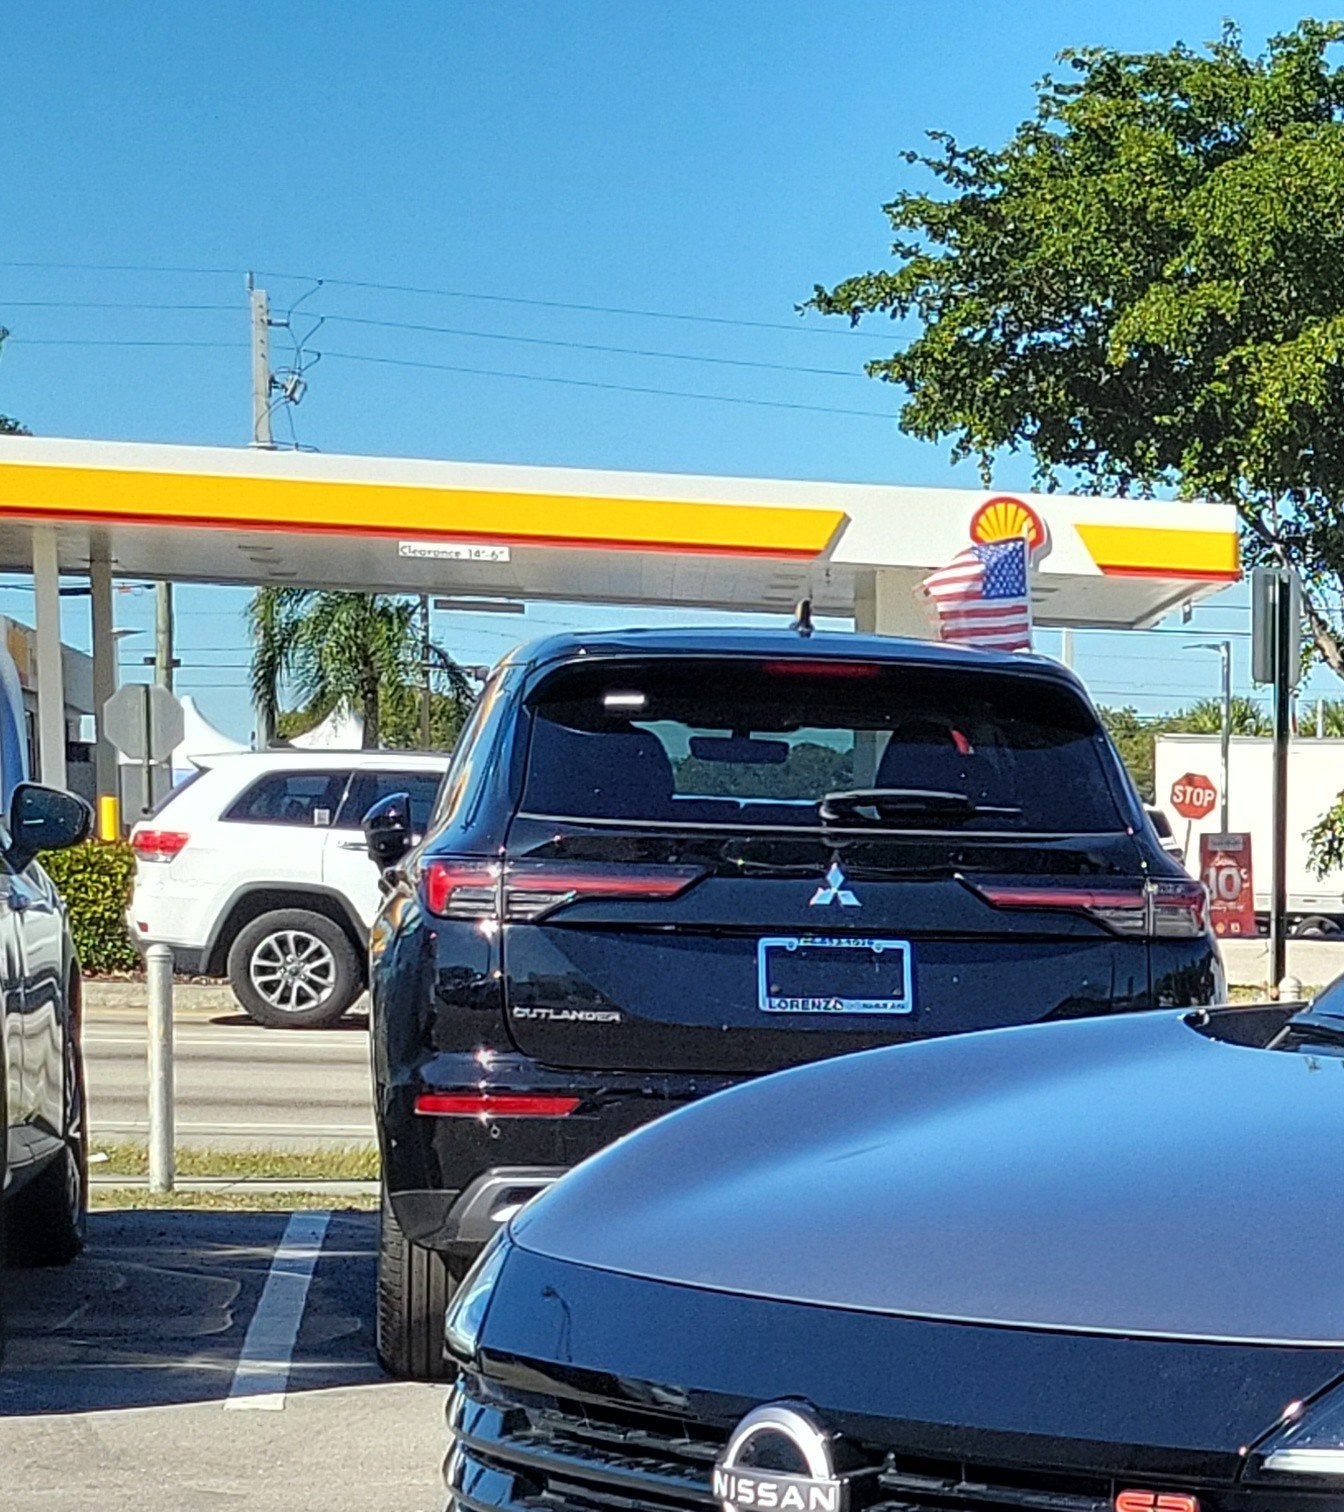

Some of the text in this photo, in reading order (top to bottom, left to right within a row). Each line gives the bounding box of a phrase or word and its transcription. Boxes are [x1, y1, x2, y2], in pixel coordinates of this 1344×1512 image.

[400, 545, 462, 558] Clearance
[1172, 784, 1216, 808] STOP
[768, 997, 844, 1011] LORENZO
[513, 1006, 622, 1022] OUTLANDER
[713, 1469, 836, 1512] NISSAN
